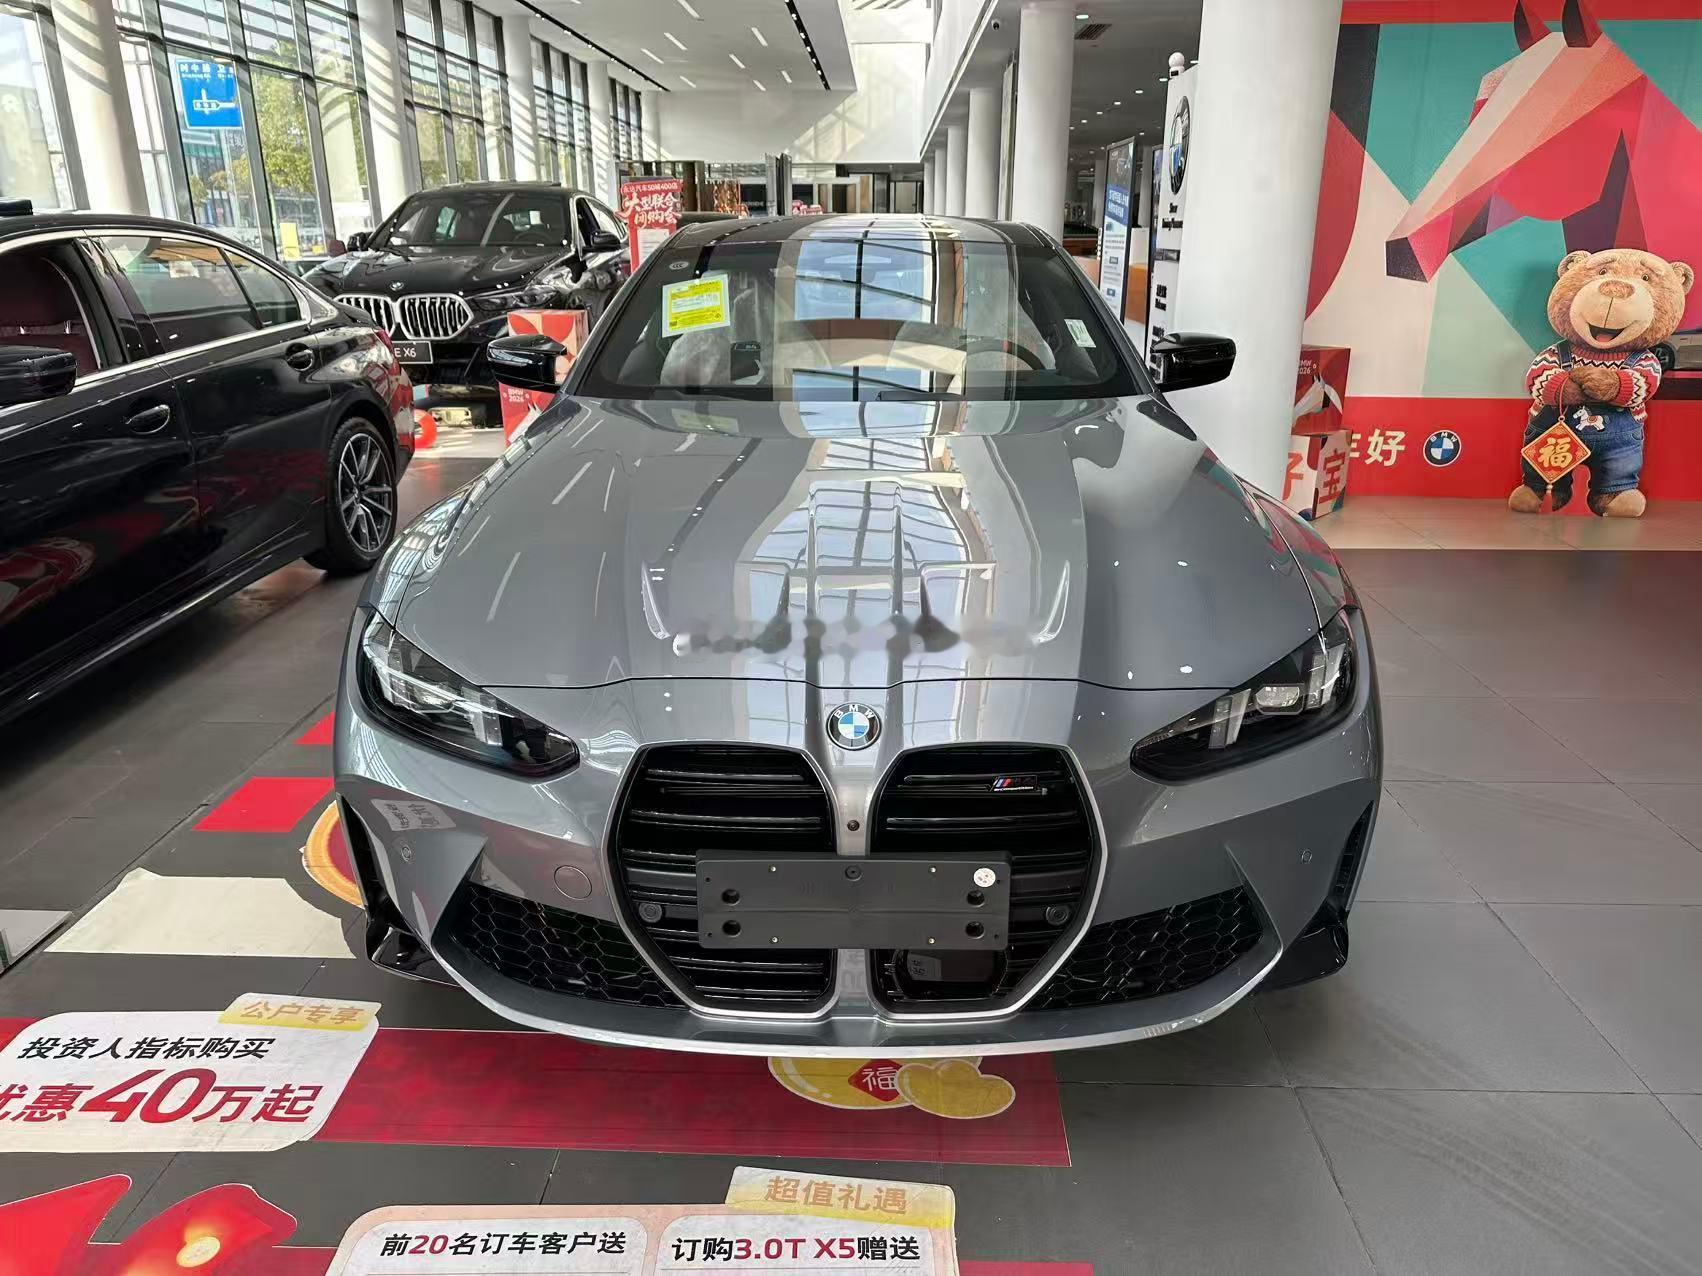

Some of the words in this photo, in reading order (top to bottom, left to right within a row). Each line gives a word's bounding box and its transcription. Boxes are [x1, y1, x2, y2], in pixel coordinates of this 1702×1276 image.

[402, 347, 417, 358] X6
[1429, 431, 1458, 443] BMW
[1537, 437, 1573, 468] 福
[1319, 448, 1346, 504] 宝
[833, 704, 875, 719] BMW
[240, 1001, 364, 1024] 公户专享
[17, 1036, 276, 1060] 投资人指标购买
[862, 1067, 899, 1091] 福
[764, 1176, 907, 1215] 超值礼遇
[380, 1232, 627, 1257] 前20名订车客户送
[671, 1237, 806, 1261] 订购3.0T
[813, 1236, 921, 1261] X5赠送
